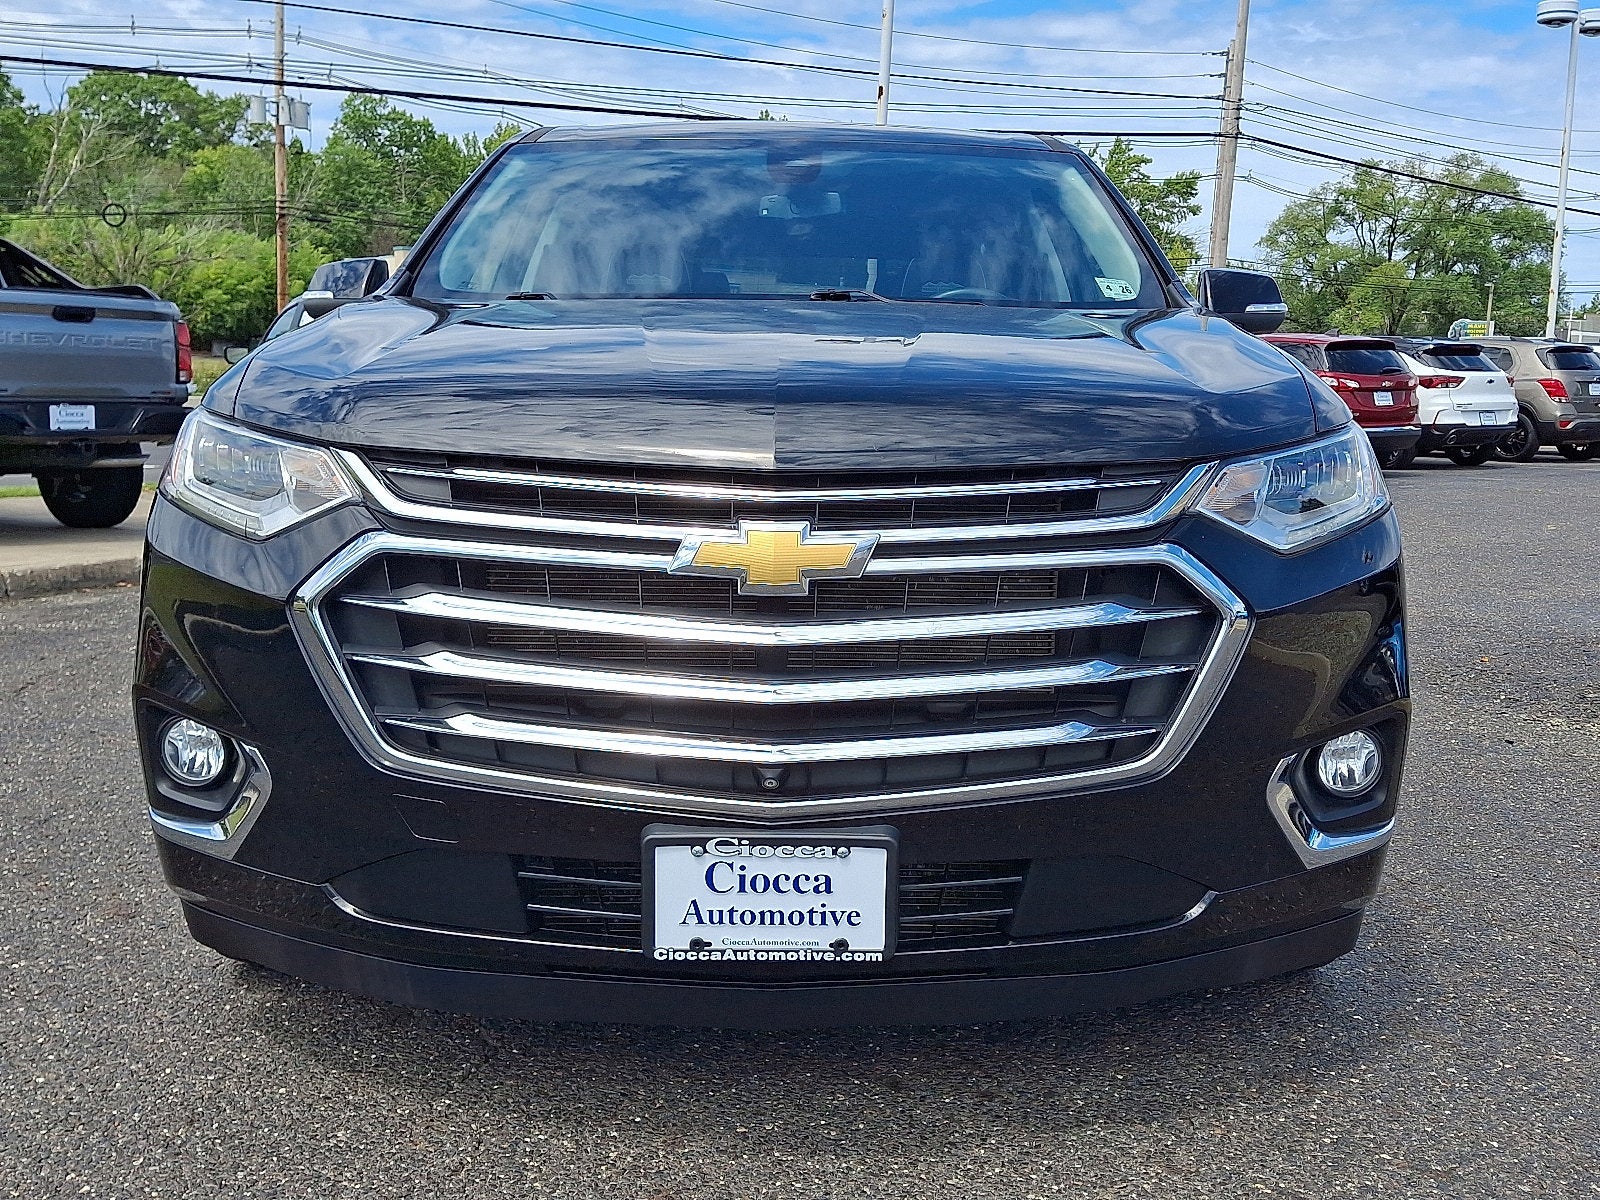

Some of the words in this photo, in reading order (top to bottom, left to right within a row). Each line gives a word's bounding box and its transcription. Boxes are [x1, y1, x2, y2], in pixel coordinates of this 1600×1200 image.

[705, 837, 836, 859] Ciocca
[704, 860, 834, 895] Ciocca
[678, 898, 862, 927] Automotive
[721, 937, 820, 948] CioccaAutomotive.com
[653, 948, 883, 962] CioccaAutomotive.com
